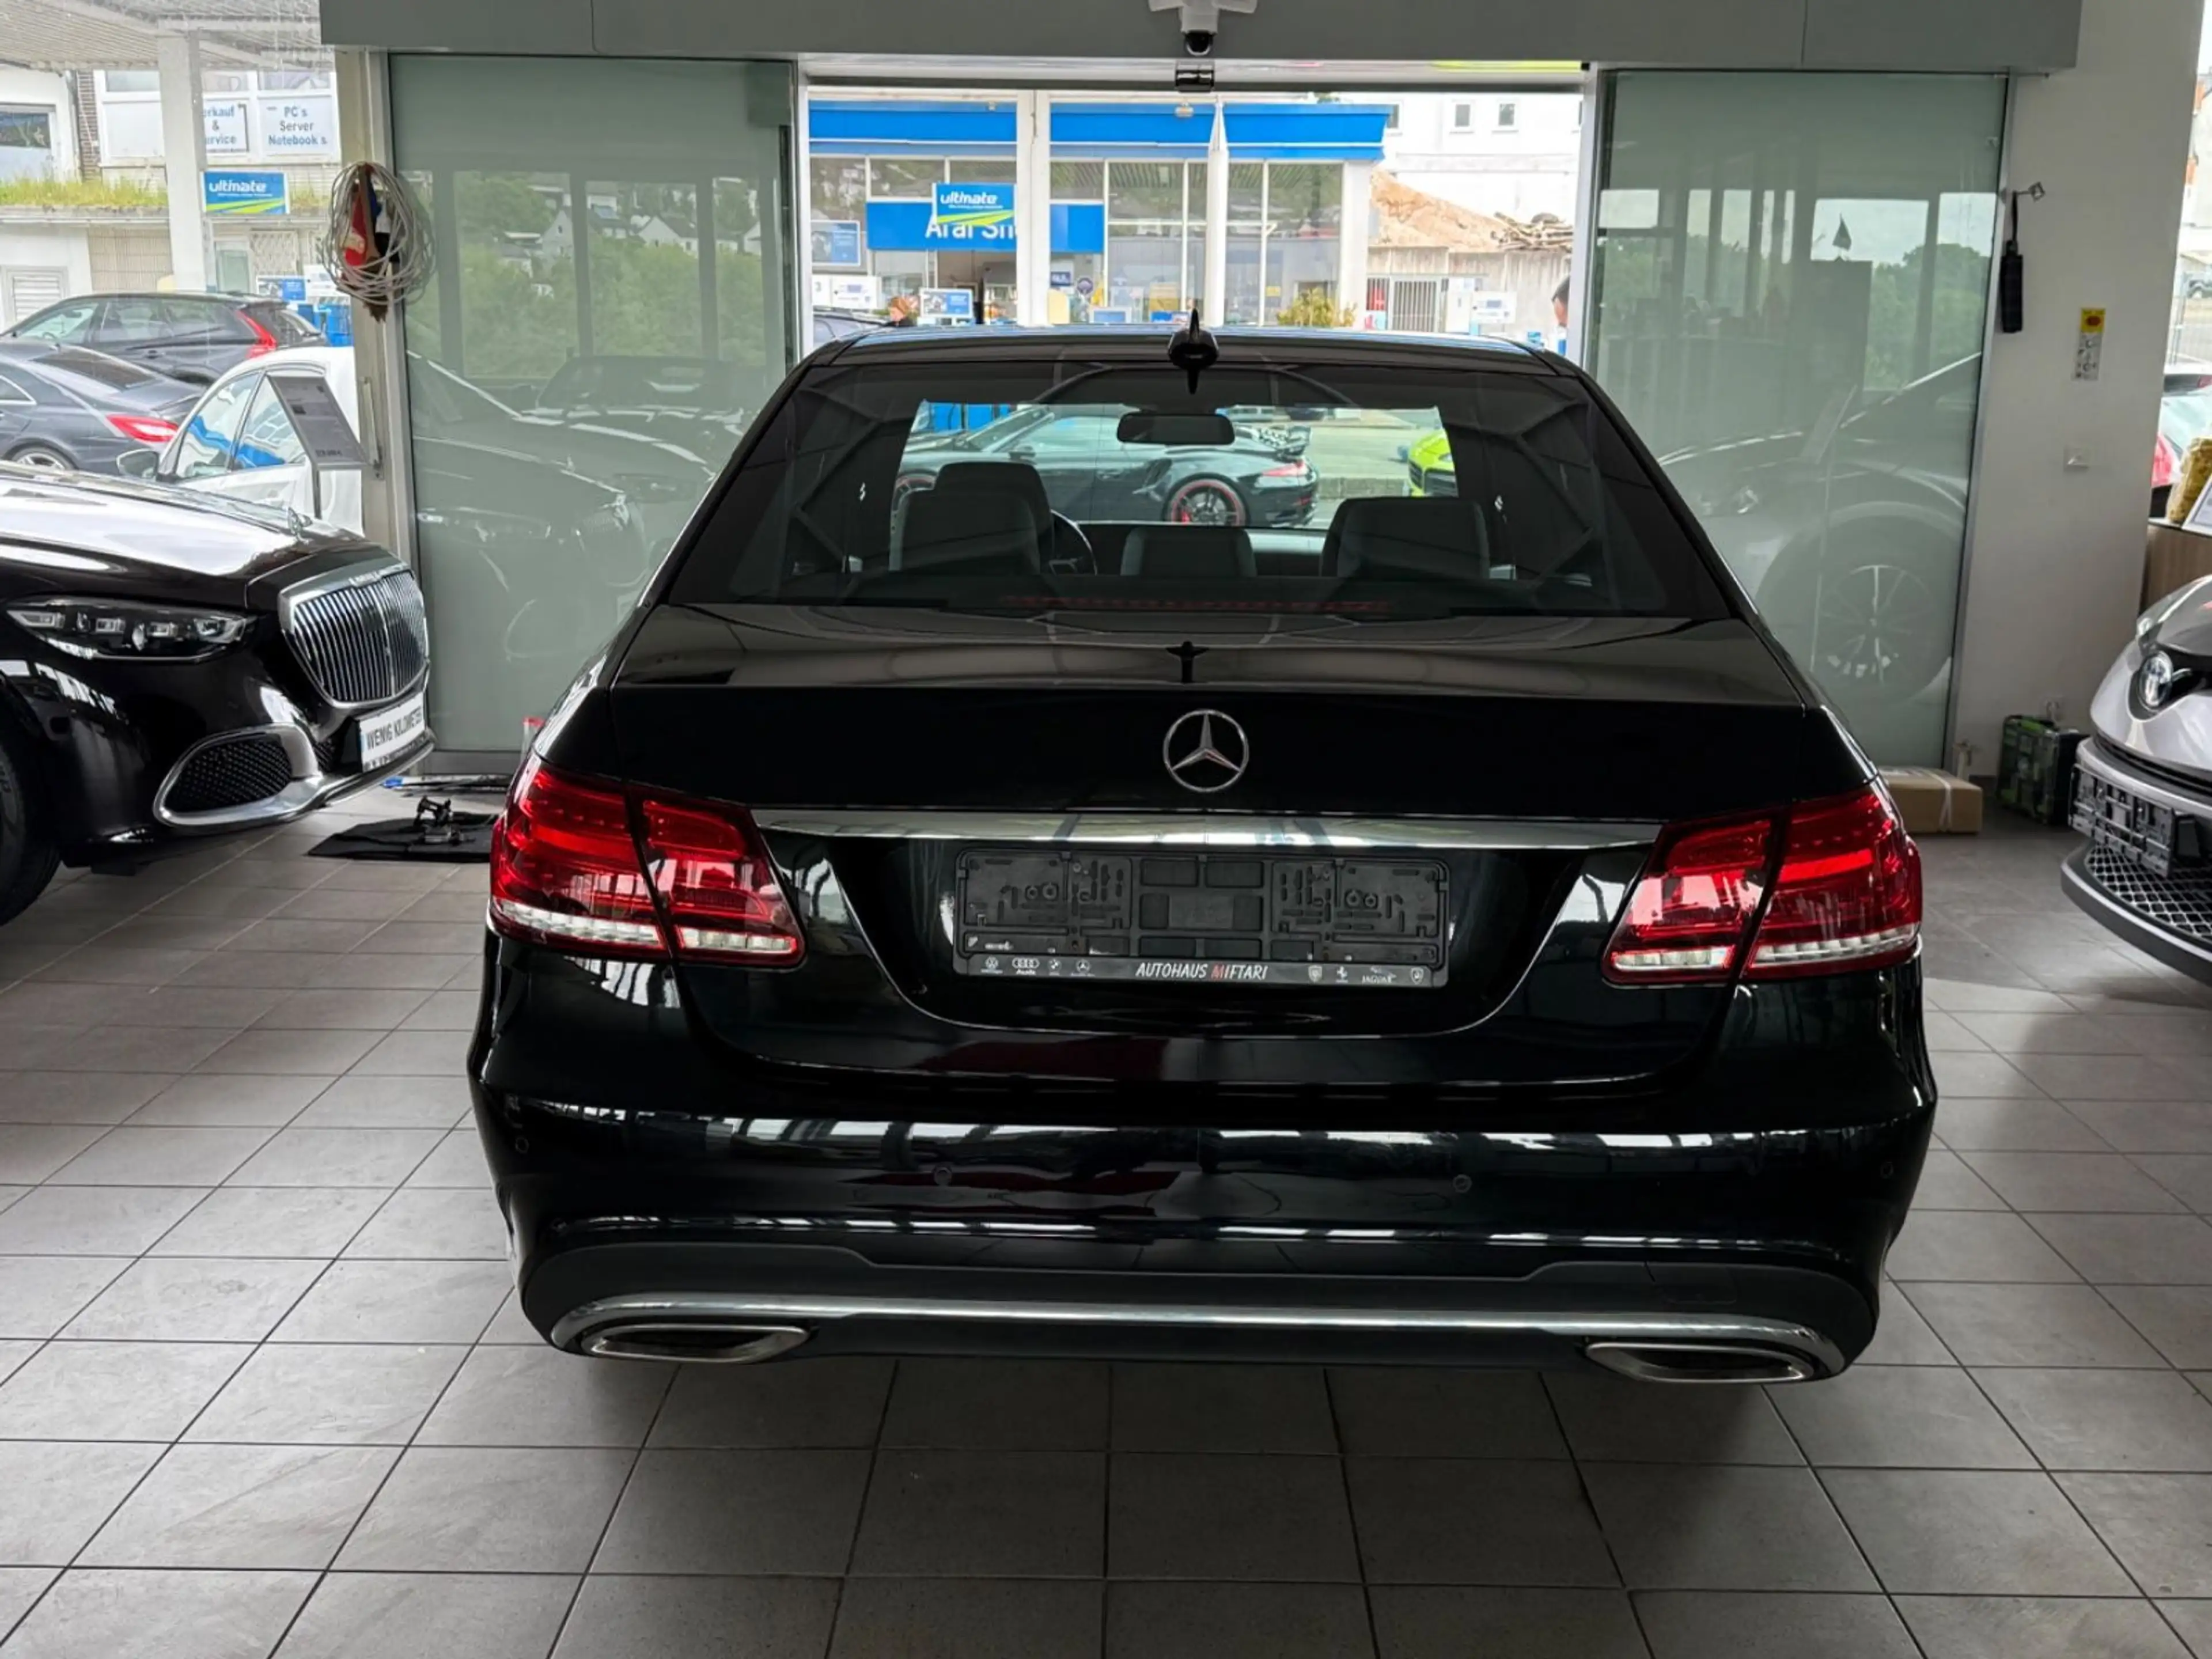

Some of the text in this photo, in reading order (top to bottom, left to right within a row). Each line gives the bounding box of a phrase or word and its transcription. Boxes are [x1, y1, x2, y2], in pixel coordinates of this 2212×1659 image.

[211, 119, 219, 131] &
[279, 120, 315, 132] Server
[209, 180, 266, 192] ultimate
[940, 191, 998, 204] ultimate
[367, 723, 393, 751] WENIG
[1135, 962, 1268, 980] AUTOHAUS MIFTARI
